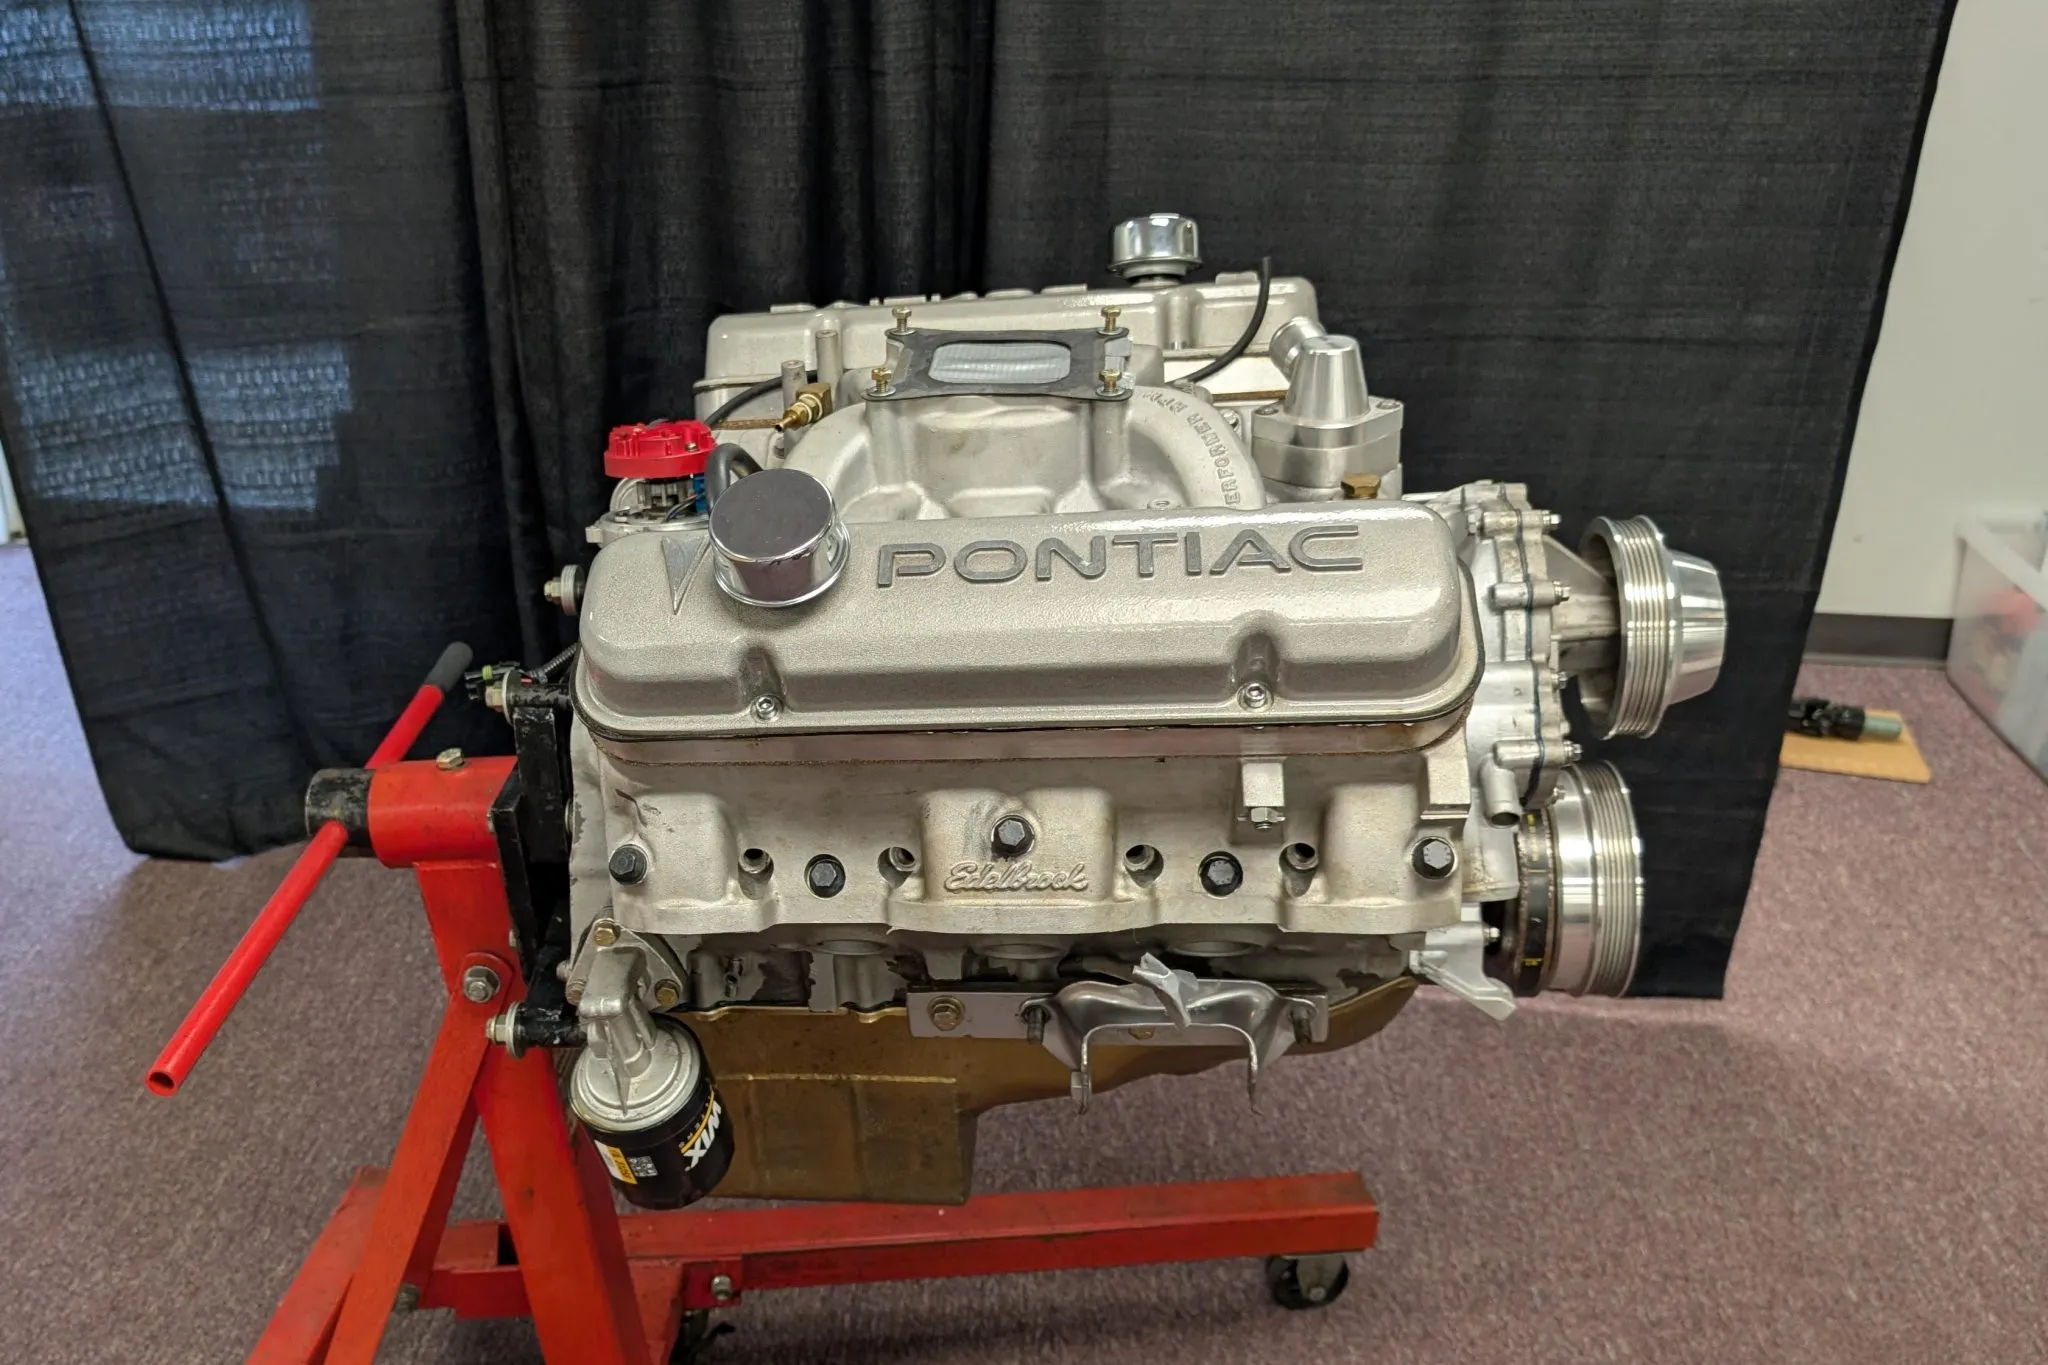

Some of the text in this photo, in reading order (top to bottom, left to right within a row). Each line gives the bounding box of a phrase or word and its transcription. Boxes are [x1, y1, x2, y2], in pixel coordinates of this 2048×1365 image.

[1187, 411, 1241, 507] ERFORMER
[877, 524, 1364, 587] PONTIAC
[944, 860, 1089, 894] Edelbrock
[683, 1100, 722, 1169] WIX
